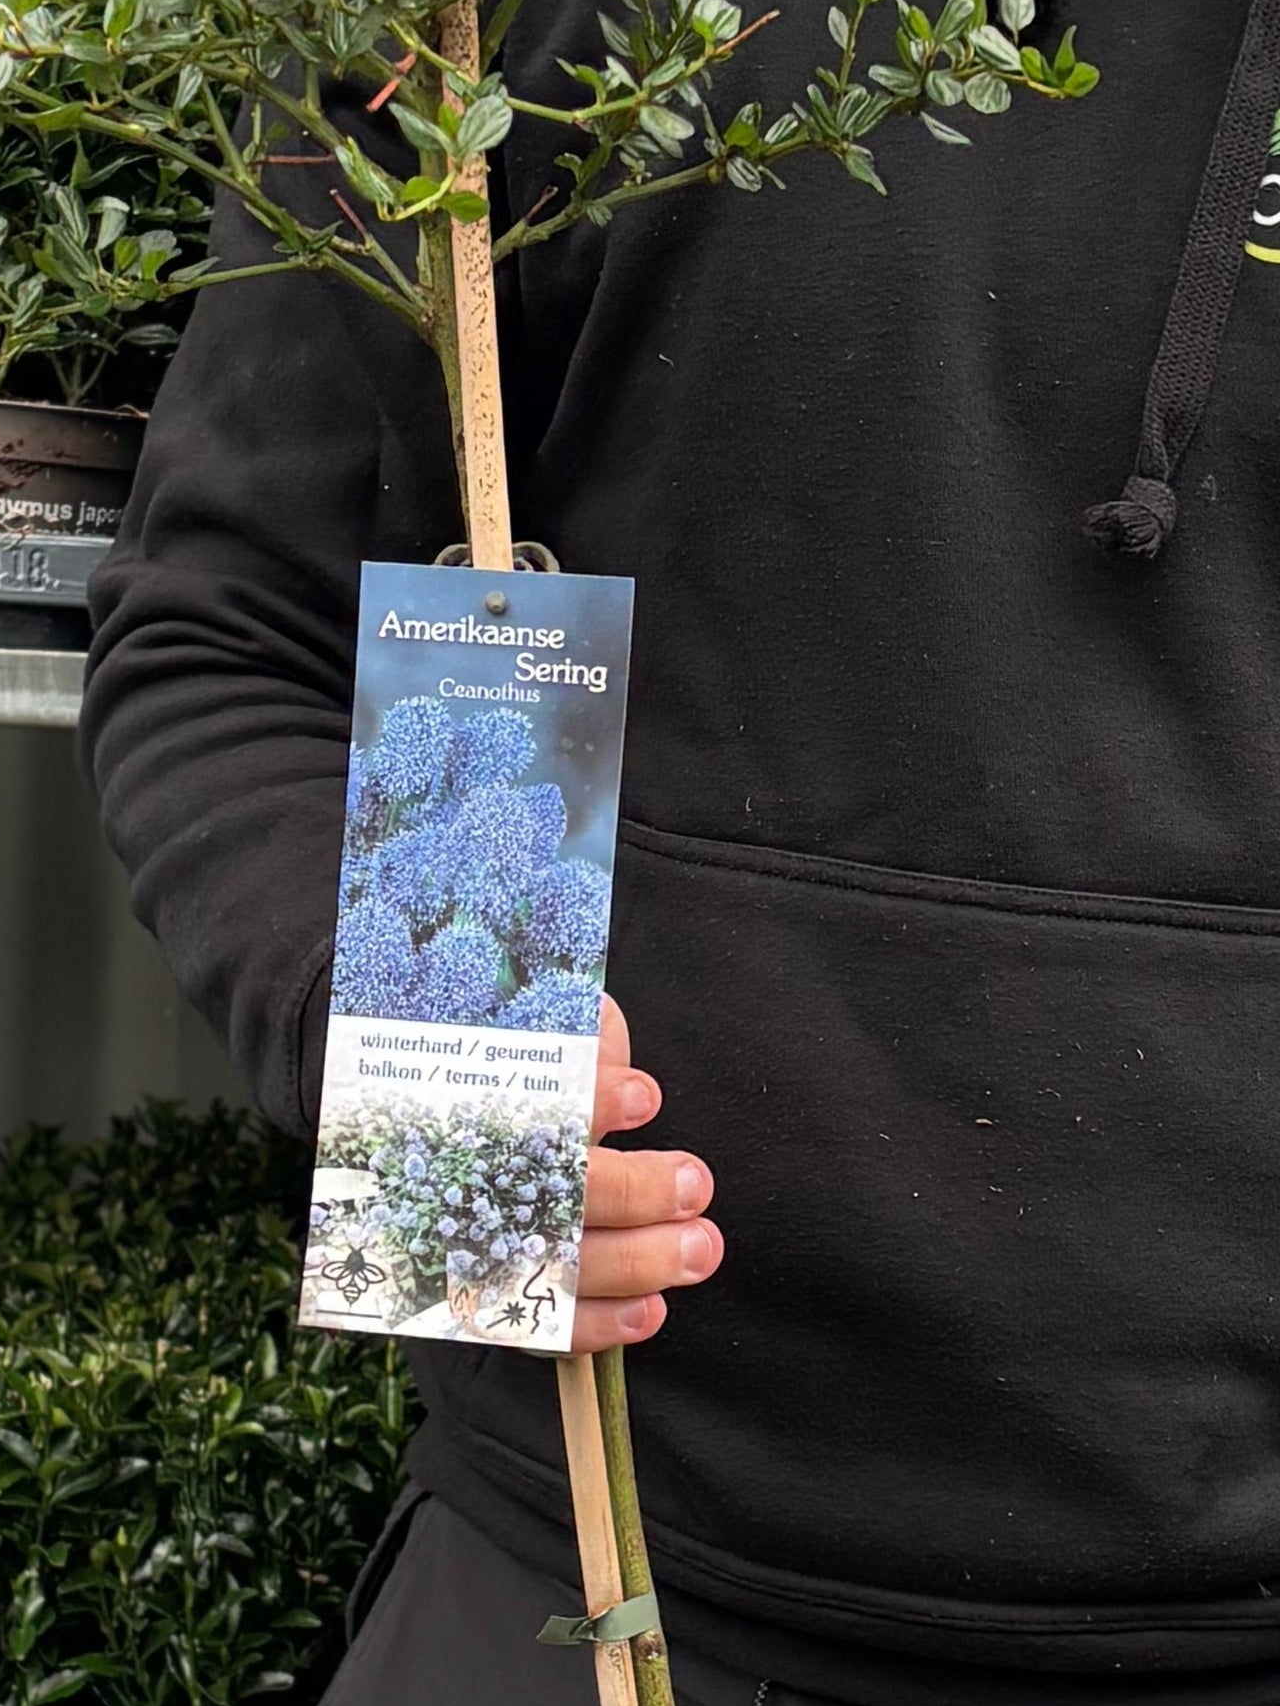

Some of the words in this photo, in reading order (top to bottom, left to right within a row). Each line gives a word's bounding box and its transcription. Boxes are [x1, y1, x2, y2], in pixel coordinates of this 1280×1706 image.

[377, 609, 566, 650] Amerikaanse
[438, 677, 541, 704] Ceanothus
[514, 653, 608, 693] Sering
[361, 1033, 463, 1056] winterhard
[485, 1045, 563, 1064] geurend
[359, 1058, 422, 1081] balkon
[445, 1068, 500, 1087] terras
[523, 1073, 560, 1093] tuin
